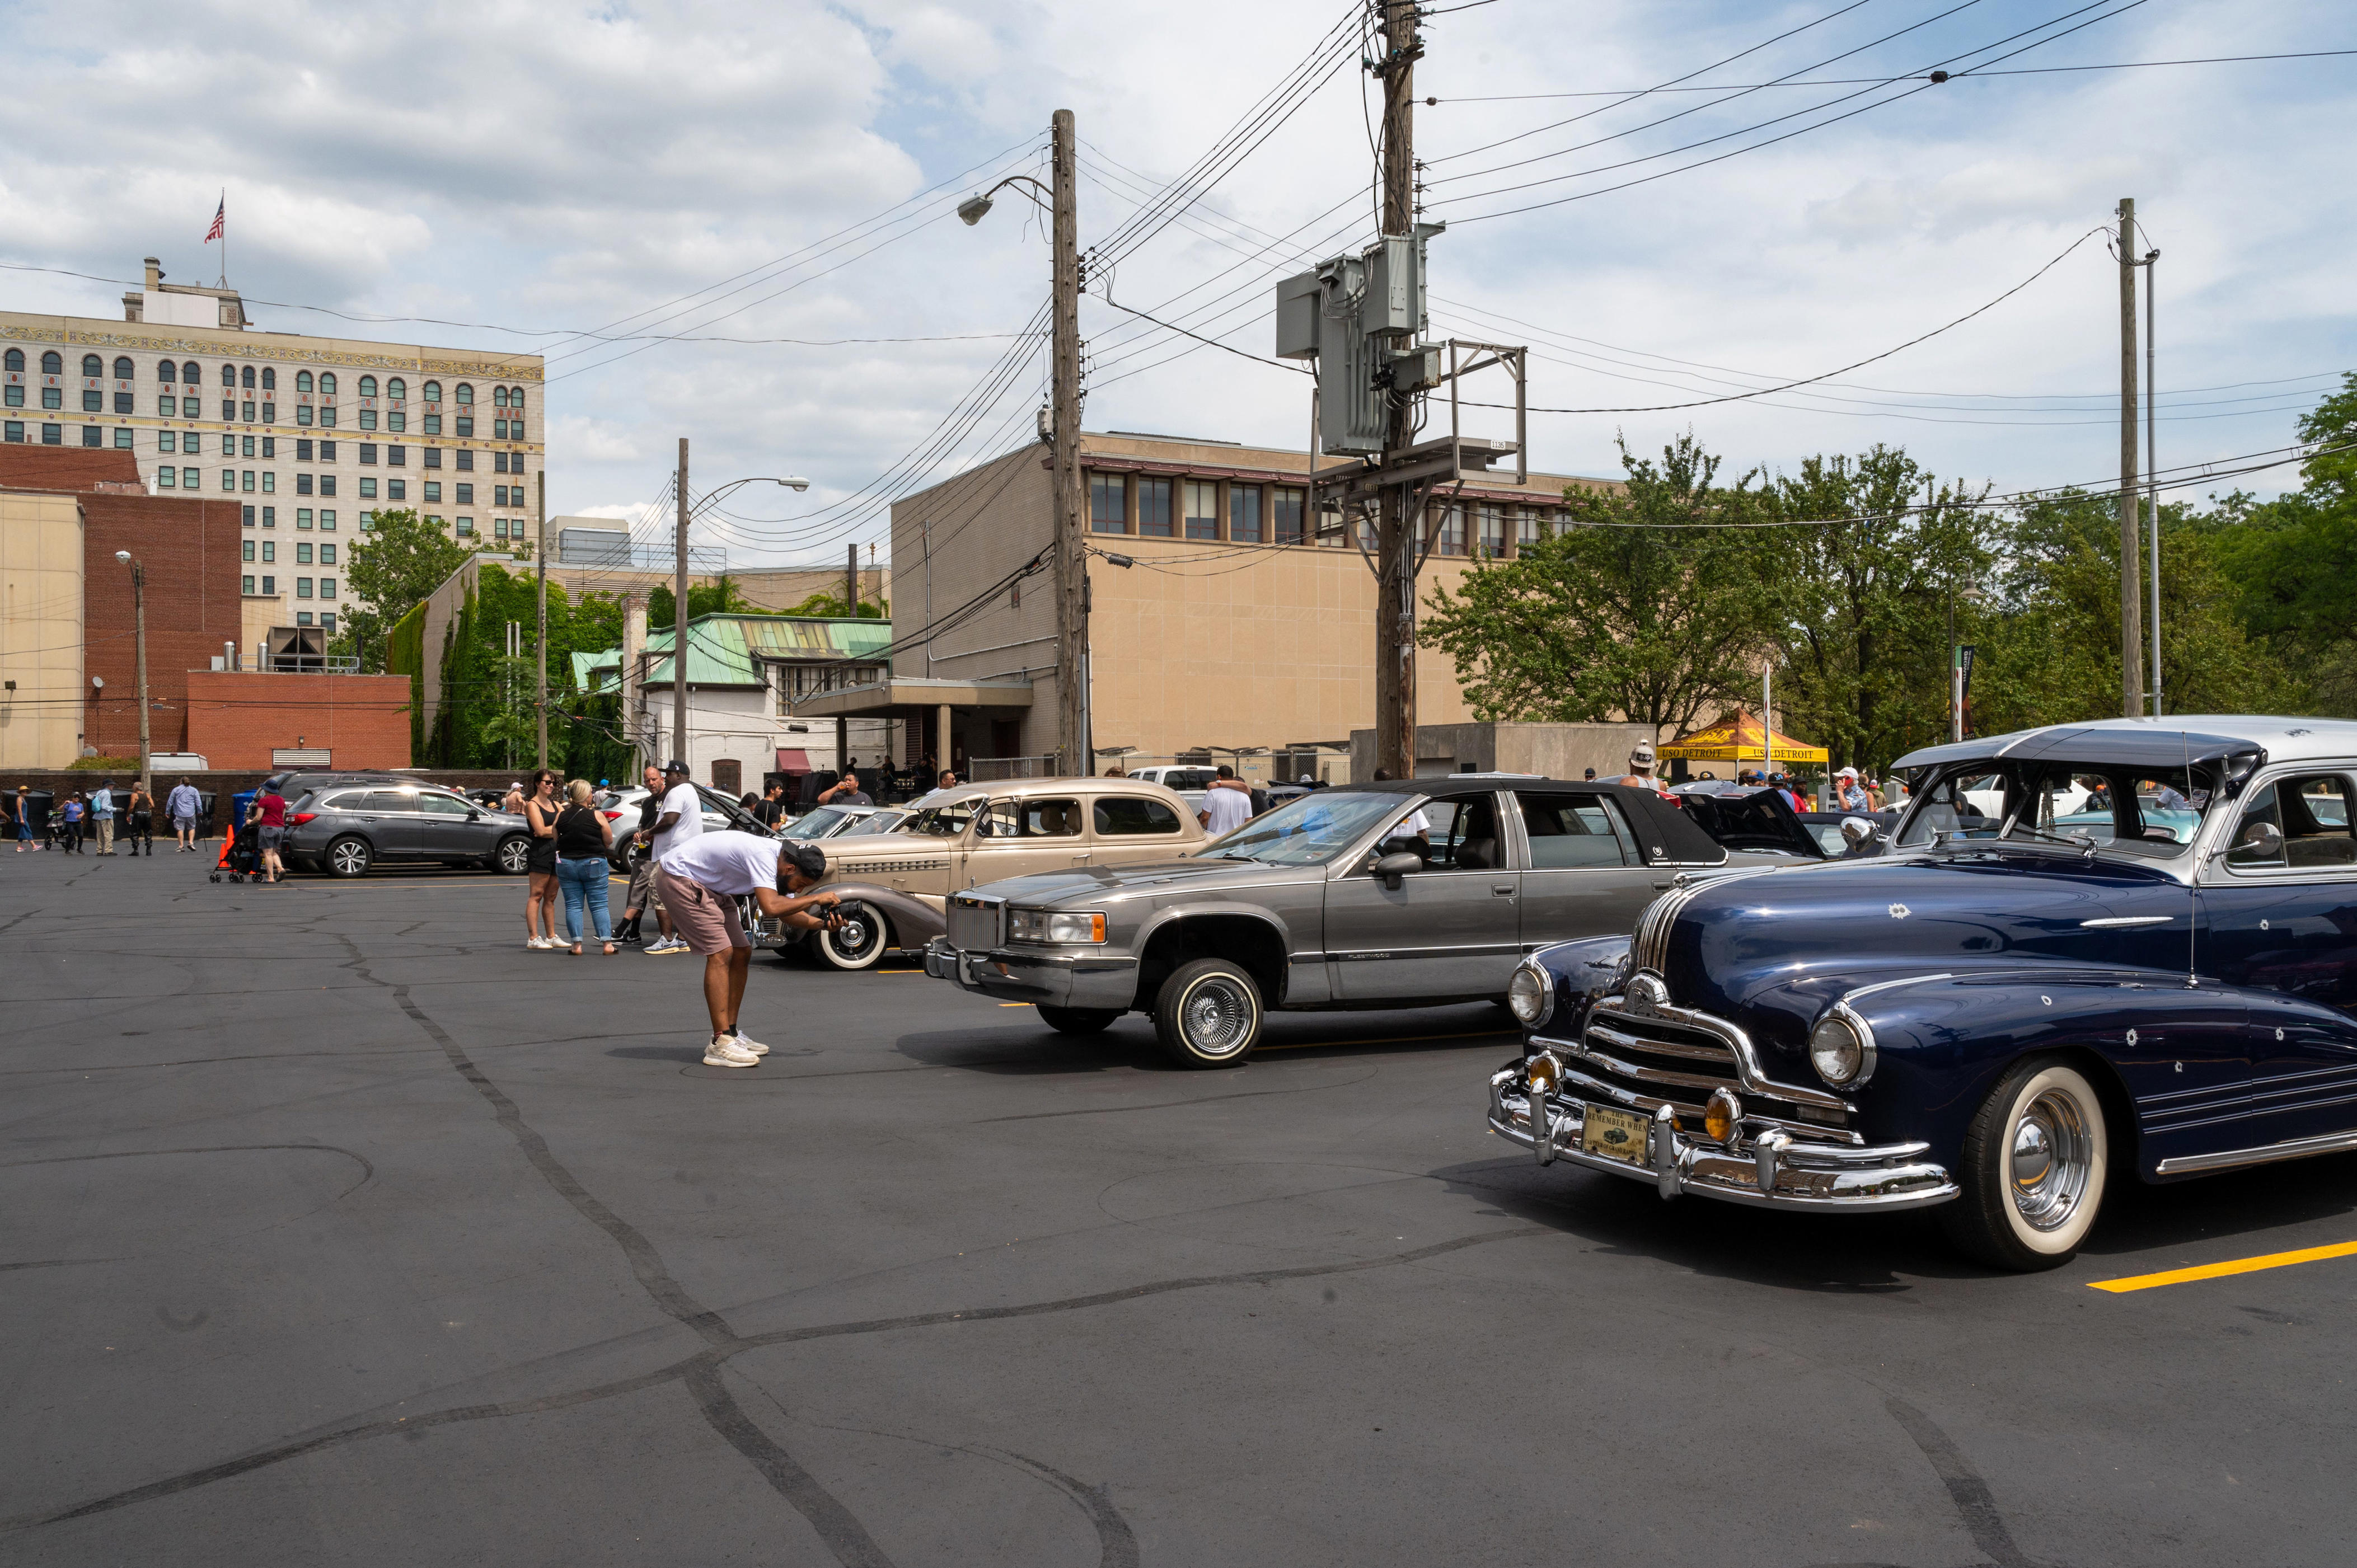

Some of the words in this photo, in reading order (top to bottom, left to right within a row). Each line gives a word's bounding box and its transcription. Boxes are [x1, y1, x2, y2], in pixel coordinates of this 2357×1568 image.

[1662, 749, 1679, 757] USO
[1682, 749, 1722, 757] DETROIT
[1754, 749, 1770, 757] US
[1774, 749, 1814, 759] DETROIT
[1611, 1110, 1624, 1119] THE
[1587, 1112, 1625, 1128] REMEMBER
[1627, 1121, 1647, 1133] WHEN
